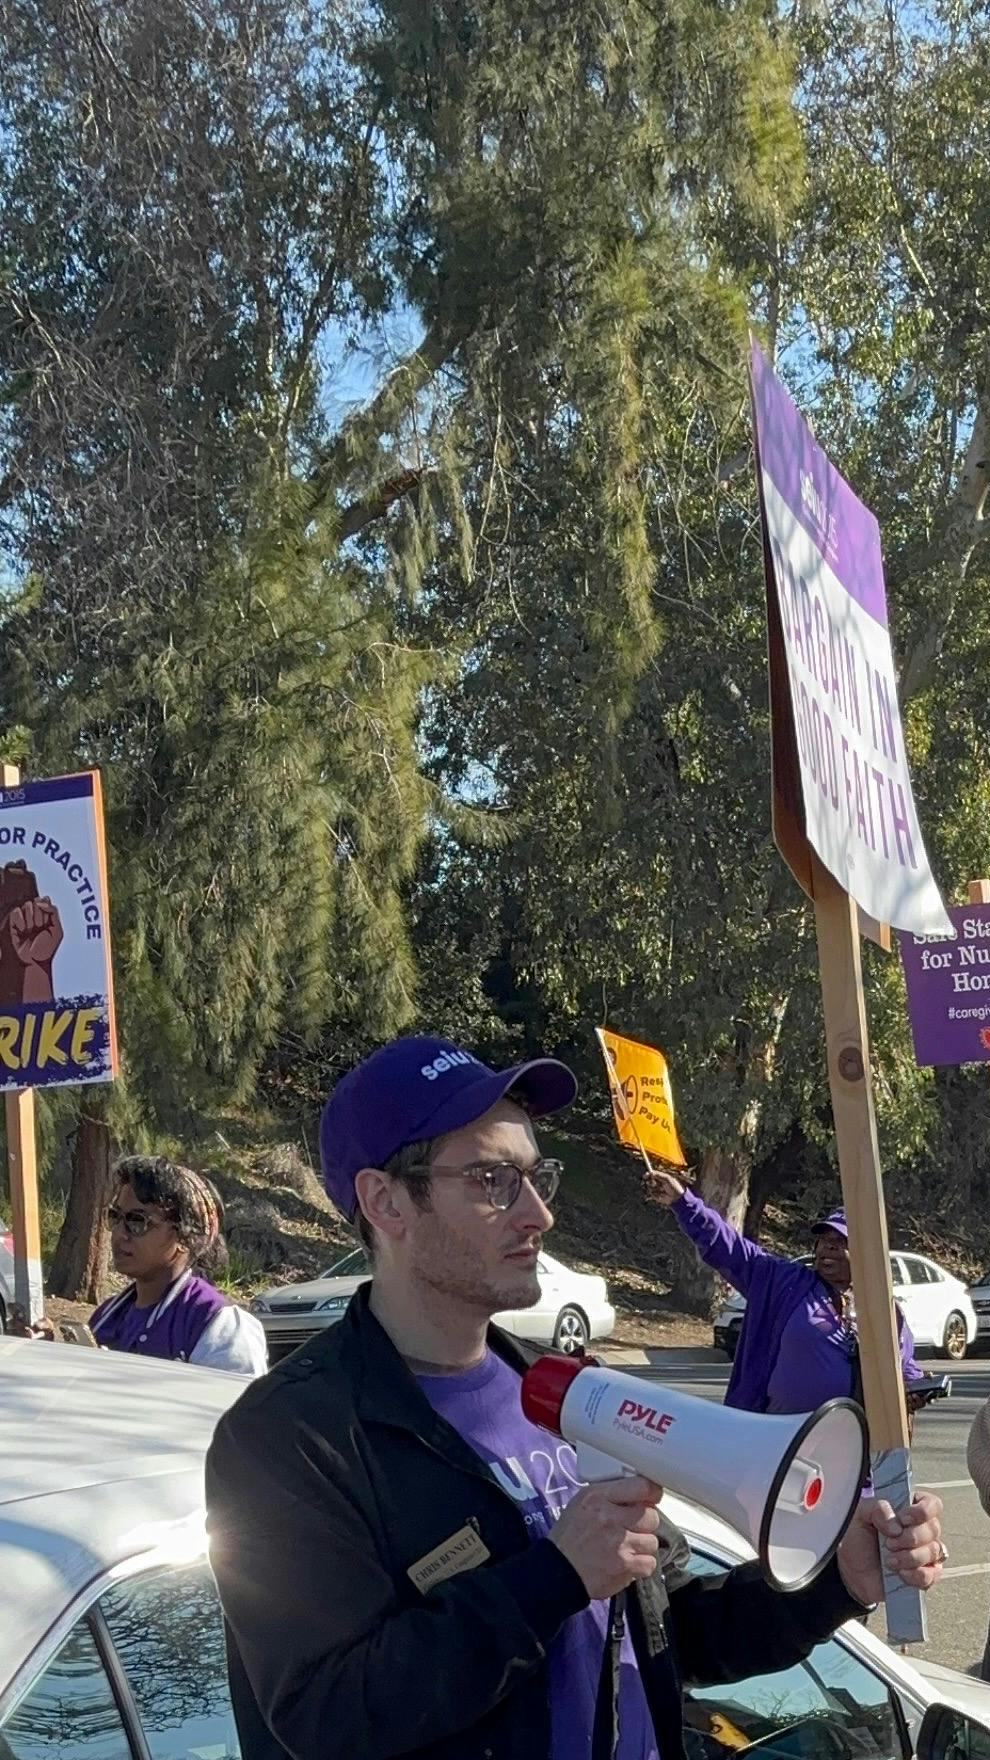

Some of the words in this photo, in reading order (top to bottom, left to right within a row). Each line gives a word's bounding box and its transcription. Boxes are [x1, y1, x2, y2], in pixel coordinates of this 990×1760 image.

[865, 658, 897, 763] IN
[842, 734, 918, 870] FAITH
[32, 831, 102, 940] PRACTICE
[921, 949, 953, 971] for
[638, 1106, 660, 1125] Pay
